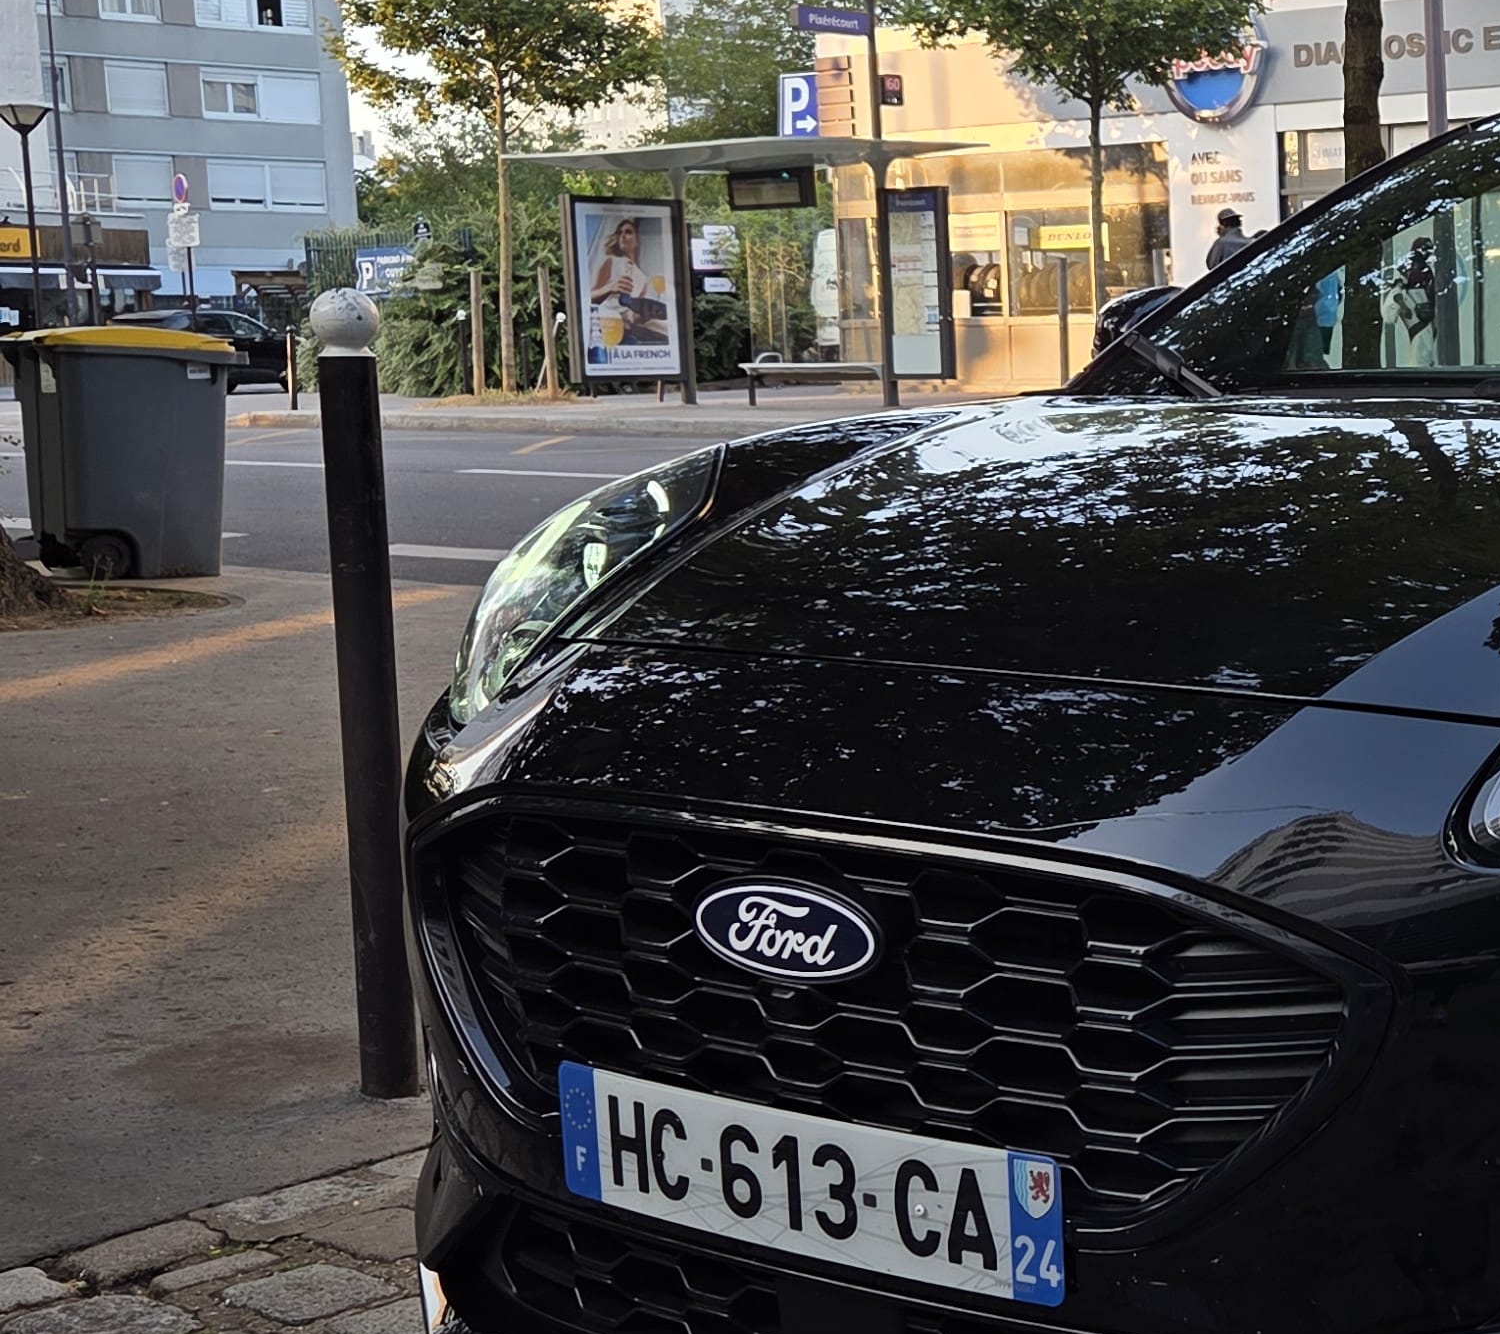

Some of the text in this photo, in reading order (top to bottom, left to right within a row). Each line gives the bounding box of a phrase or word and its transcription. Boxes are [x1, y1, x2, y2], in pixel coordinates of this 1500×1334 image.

[808, 12, 860, 30] Pixérécourt
[1293, 28, 1474, 68] DIAOSIC
[1191, 151, 1221, 165] AVEC
[1191, 169, 1242, 185] OU SANS
[1048, 232, 1092, 241] DUNLO
[621, 349, 632, 359] LA
[633, 349, 671, 359] FRENCH
[728, 896, 838, 966] Ford
[575, 1145, 587, 1171] F
[608, 1094, 997, 1271] HC-613-CA
[1014, 1235, 1063, 1287] 24
